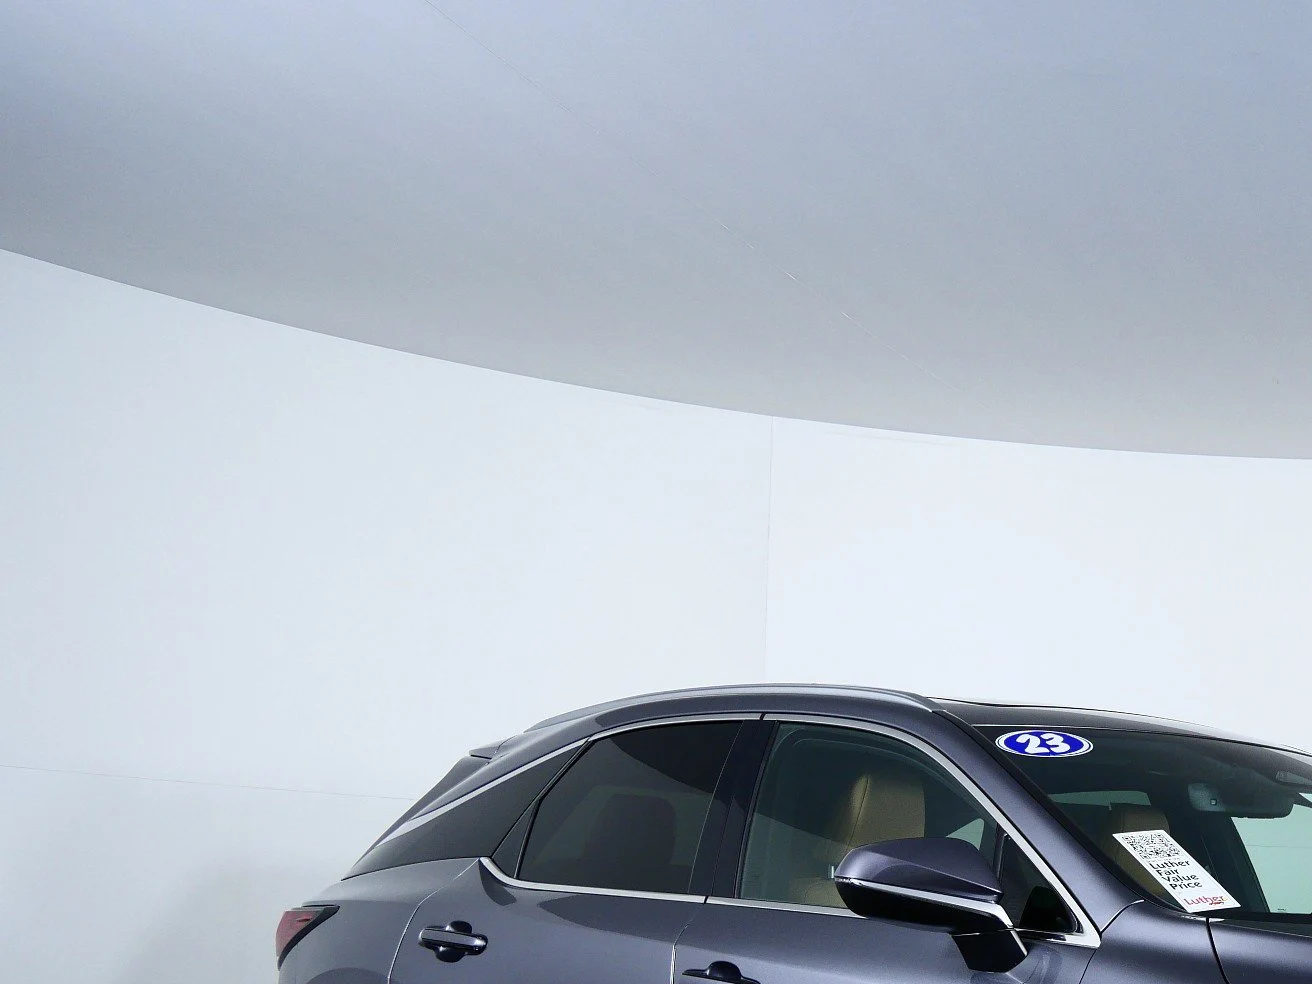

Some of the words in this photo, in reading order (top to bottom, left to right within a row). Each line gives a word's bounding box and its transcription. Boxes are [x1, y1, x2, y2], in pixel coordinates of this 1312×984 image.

[1015, 733, 1071, 754] 23
[1149, 860, 1190, 870] Luther
[1156, 868, 1180, 877] Fair
[1161, 874, 1199, 883] Value
[1169, 881, 1203, 890] Price
[1183, 895, 1225, 906] Luther
